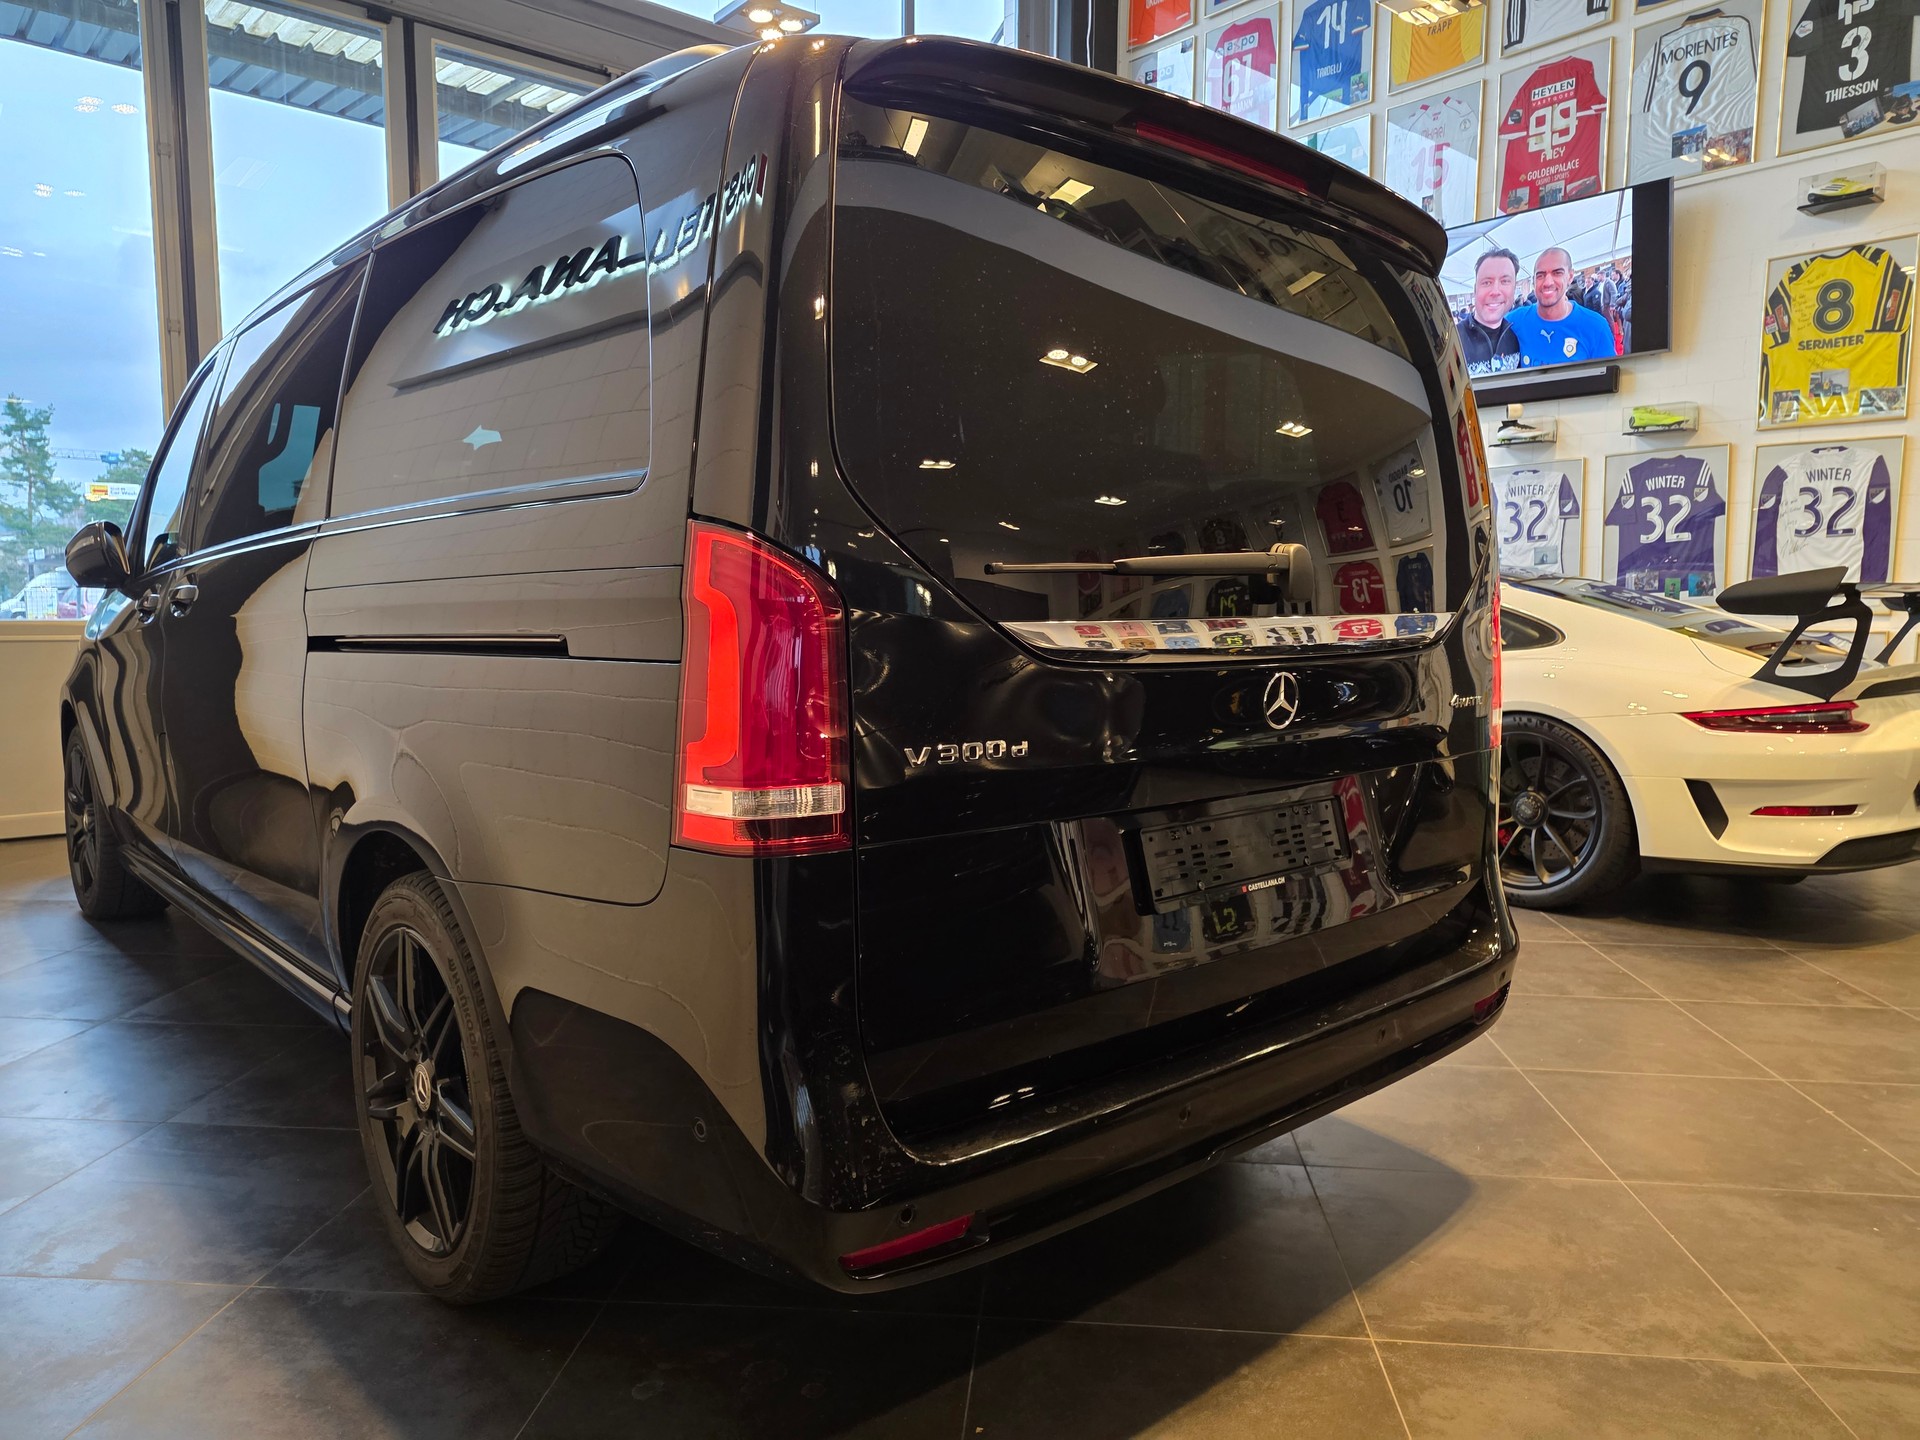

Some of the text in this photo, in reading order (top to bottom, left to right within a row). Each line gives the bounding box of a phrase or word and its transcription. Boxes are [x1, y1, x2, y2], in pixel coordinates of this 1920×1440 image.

[1316, 1, 1347, 49] 14
[1427, 19, 1453, 36] TRAPP
[1661, 32, 1738, 66] MORIENTES
[1839, 26, 1872, 81] 3
[1223, 53, 1253, 103] 61
[1533, 79, 1575, 99] HEYLEN
[1678, 60, 1711, 115] 9
[1825, 79, 1879, 103] THIESSON
[1532, 91, 1574, 107] VASTGOED
[1528, 99, 1578, 159] 99
[1411, 142, 1450, 192] 15
[1527, 159, 1580, 181] GOLDENPALACE
[1813, 279, 1854, 334] 8
[1798, 334, 1865, 351] SERMETER
[1508, 484, 1544, 498] WINTER
[1645, 475, 1686, 491] WINTER
[1806, 467, 1852, 483] WINTER
[1503, 499, 1548, 544] 32
[1640, 494, 1692, 544] 32
[1794, 486, 1857, 538] 32
[1248, 876, 1286, 892] CASTELLANA.CH
